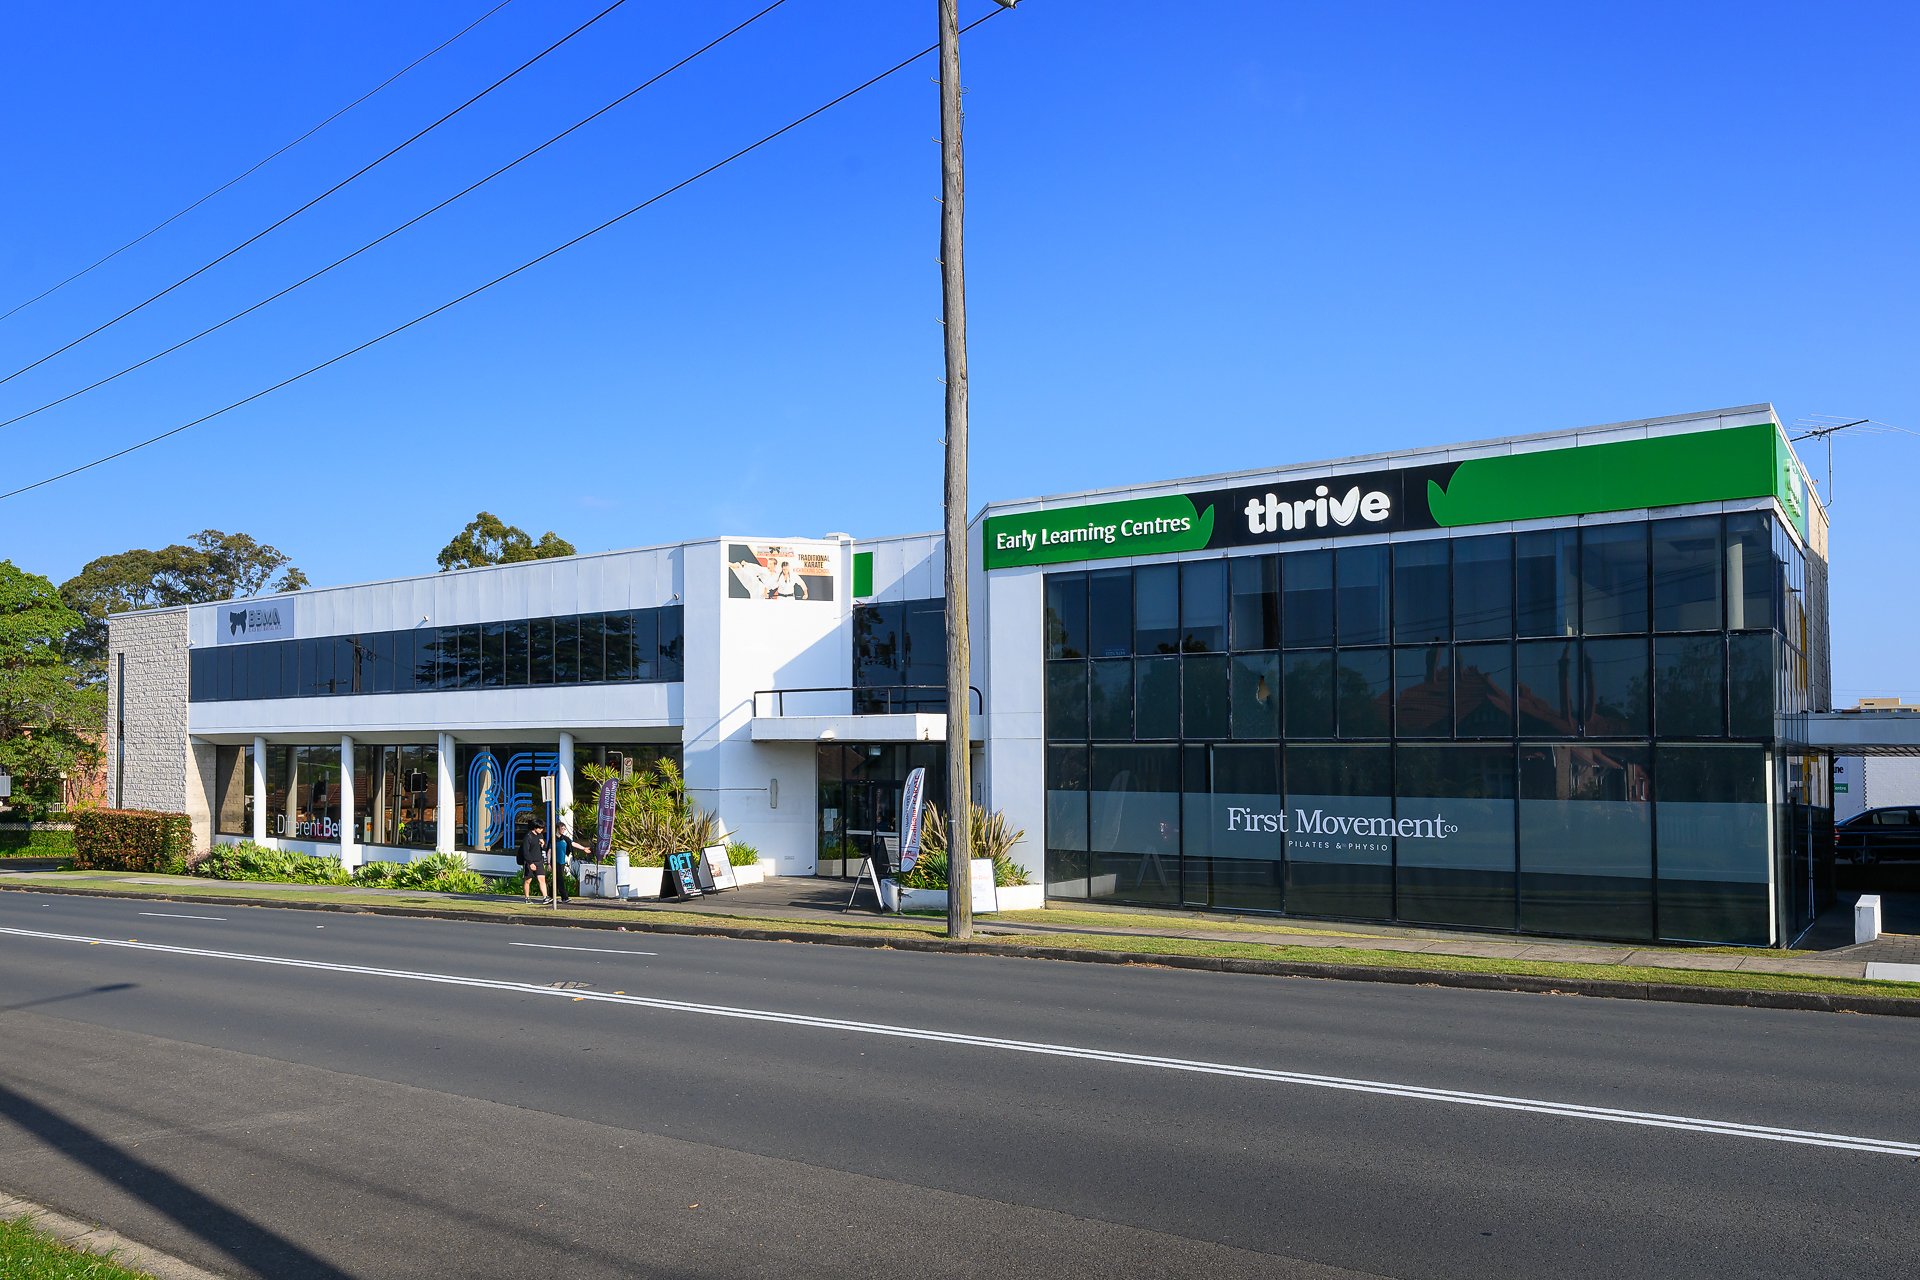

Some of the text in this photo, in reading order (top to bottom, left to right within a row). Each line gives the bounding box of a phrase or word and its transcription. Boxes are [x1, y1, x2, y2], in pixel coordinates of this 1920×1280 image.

[1244, 485, 1391, 534] thrive
[996, 516, 1191, 551] Early Learning Centres
[798, 554, 830, 562] TRADITIONAL
[248, 608, 281, 627] BBMA
[610, 781, 618, 809] TRAINING
[1227, 807, 1288, 833] First
[1295, 808, 1448, 839] Movement
[1288, 840, 1330, 849] PILATES
[1348, 843, 1388, 851] PHYSIO
[669, 852, 692, 871] BFT
